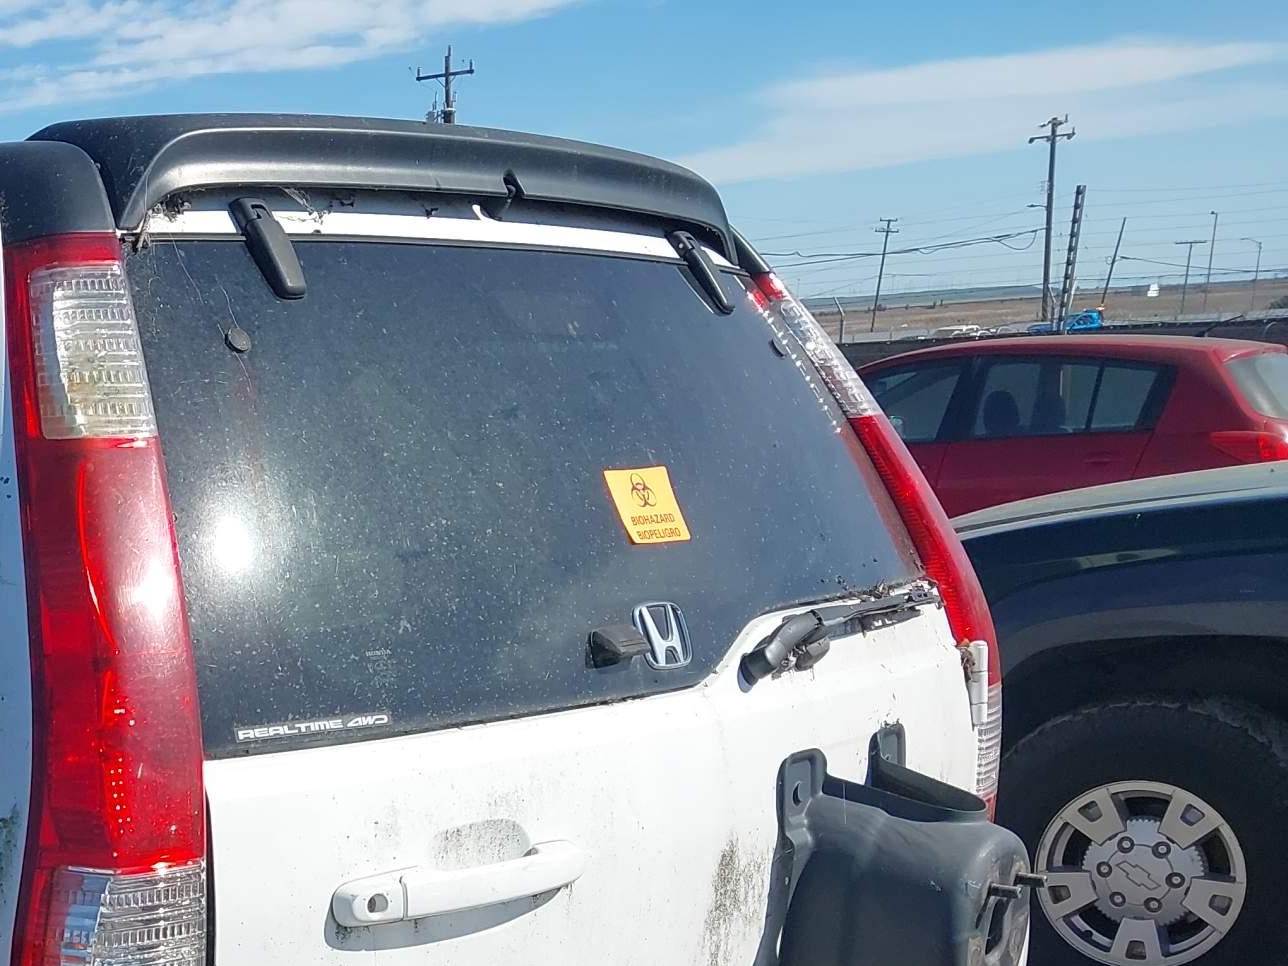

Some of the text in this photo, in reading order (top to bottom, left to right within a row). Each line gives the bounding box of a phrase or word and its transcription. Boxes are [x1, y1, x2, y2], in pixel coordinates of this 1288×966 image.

[631, 513, 675, 526] BIOHAZARD
[636, 527, 681, 540] BIOPELIGRO
[347, 714, 388, 728] 4WD
